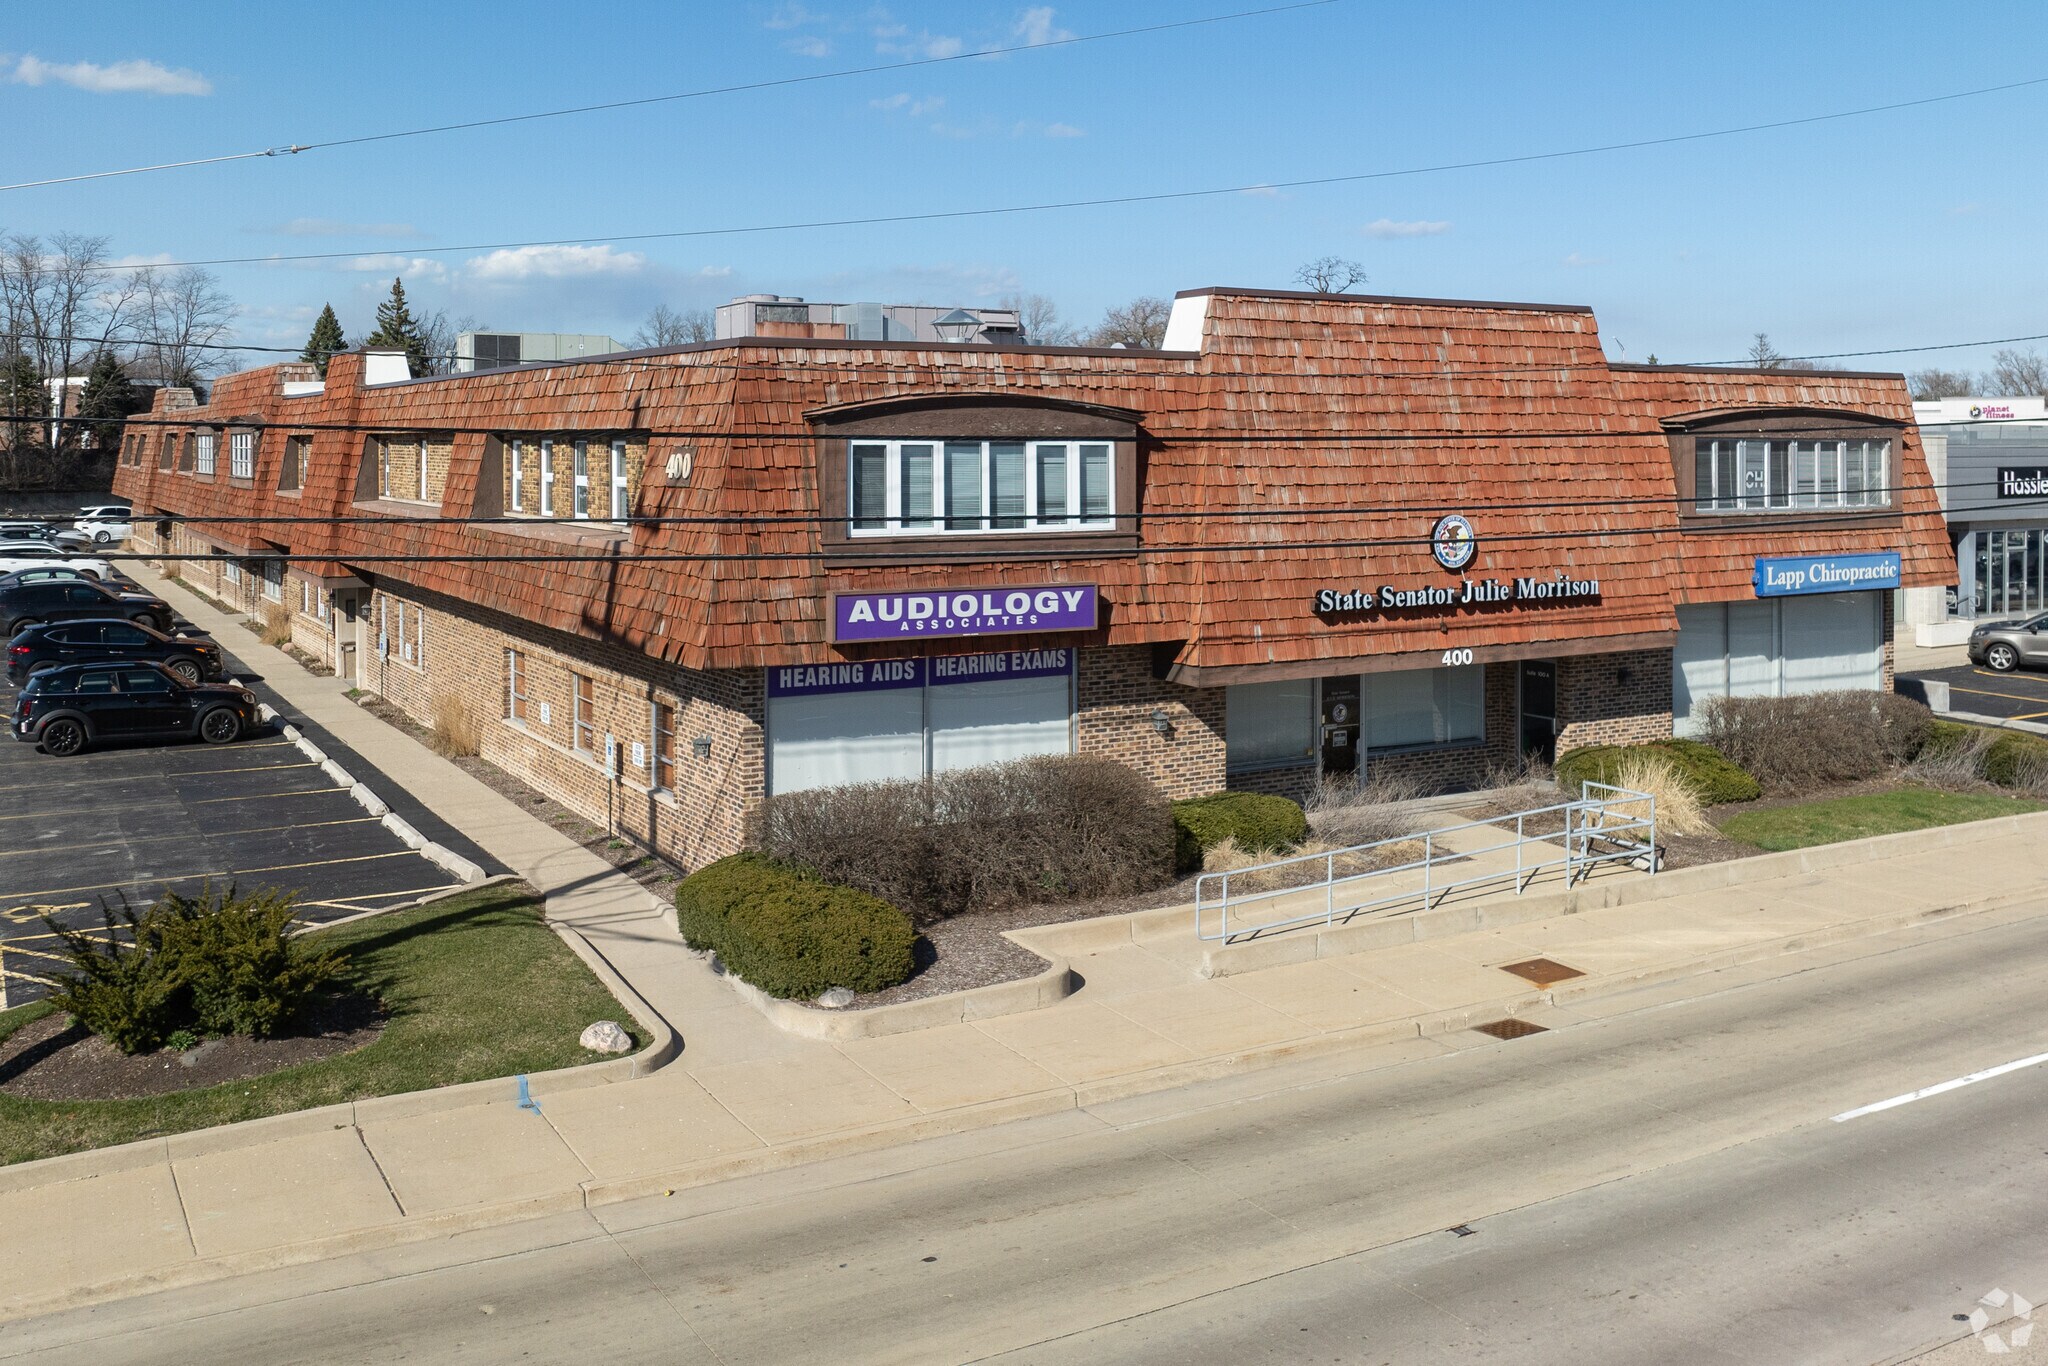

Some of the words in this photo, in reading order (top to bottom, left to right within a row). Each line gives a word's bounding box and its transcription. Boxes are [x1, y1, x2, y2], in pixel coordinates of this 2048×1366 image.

[1983, 405, 2010, 414] planet
[1985, 411, 2015, 419] fitness
[665, 453, 691, 479] 400
[2004, 470, 2048, 495] Hassle
[1767, 566, 1805, 590] Lapp
[1809, 560, 1897, 585] Chiropractic
[848, 590, 1084, 623] AUDIOLOGY
[1319, 589, 1373, 613] State
[1381, 585, 1454, 608] Senator
[1461, 579, 1509, 603] Julie
[1517, 577, 1599, 600] Morrison
[900, 614, 1038, 631] ASSOCIATES
[936, 653, 1006, 677] HEARING
[1012, 649, 1066, 670] EXAMS
[1441, 649, 1473, 666] 400
[780, 664, 864, 688] HEARING
[871, 661, 915, 682] AIDS
